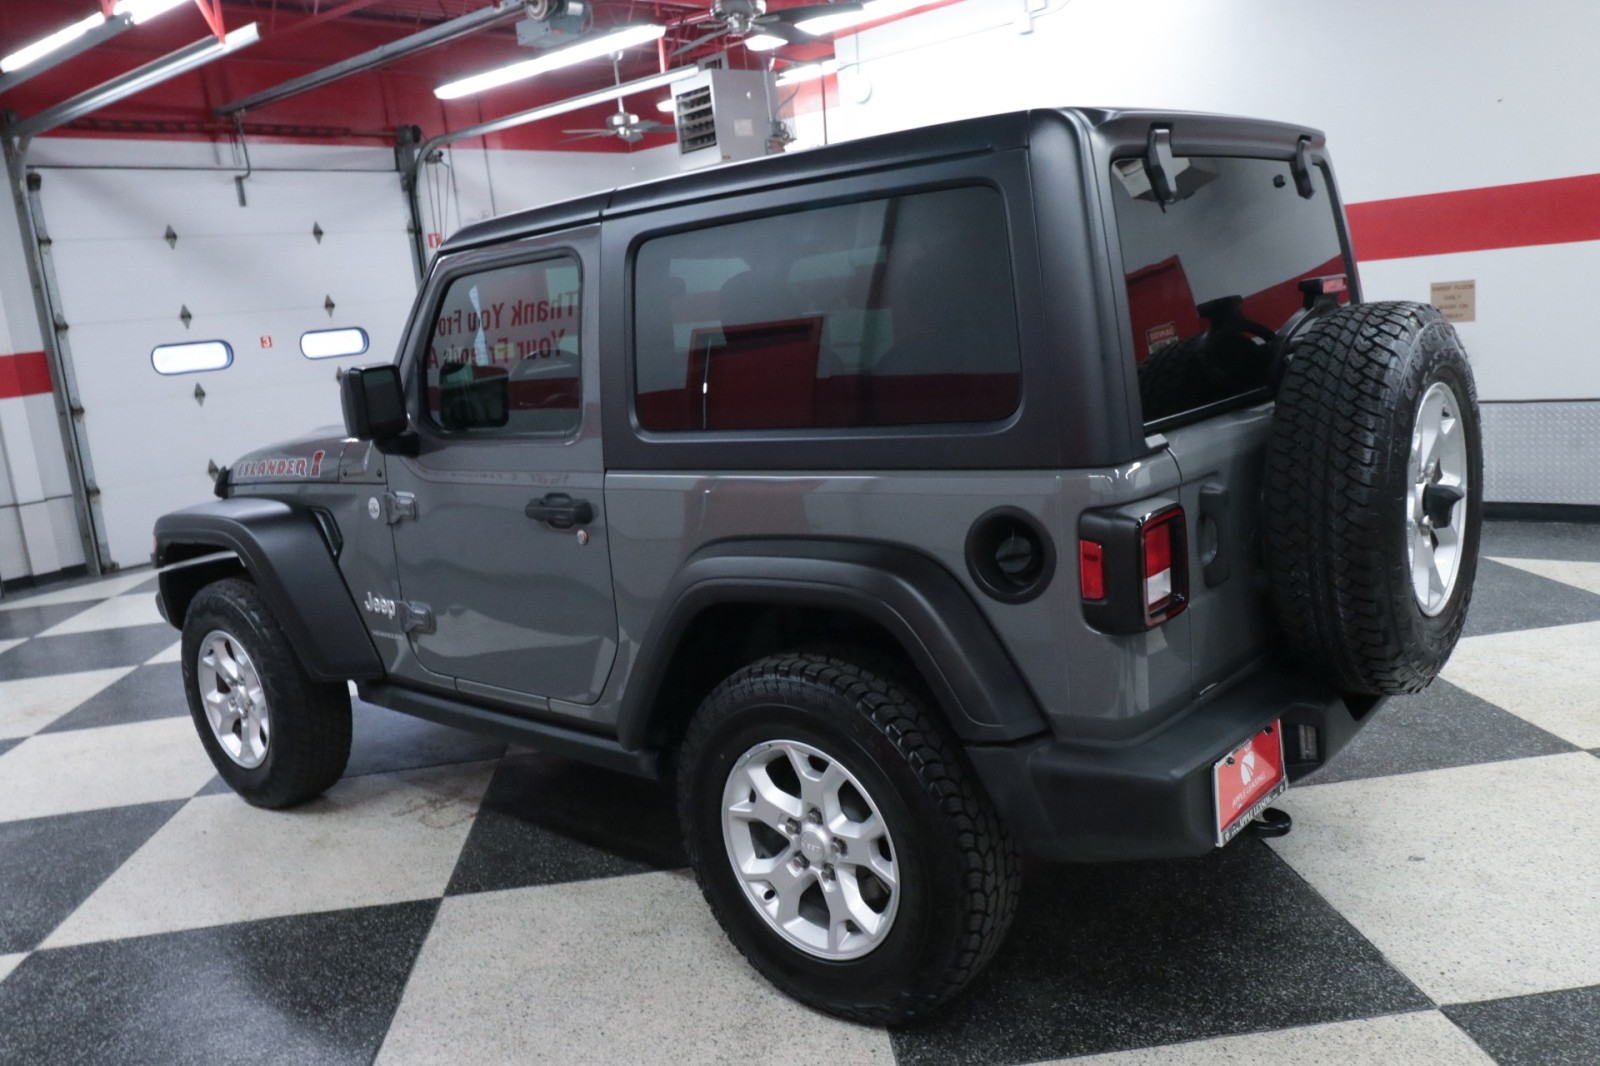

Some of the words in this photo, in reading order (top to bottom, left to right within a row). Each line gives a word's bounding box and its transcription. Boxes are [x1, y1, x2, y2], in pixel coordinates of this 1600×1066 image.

[237, 457, 307, 479] ISLANDER
[364, 591, 396, 620] Jeep
[1231, 789, 1246, 808] APPLE
[1246, 771, 1266, 794] LEASING
